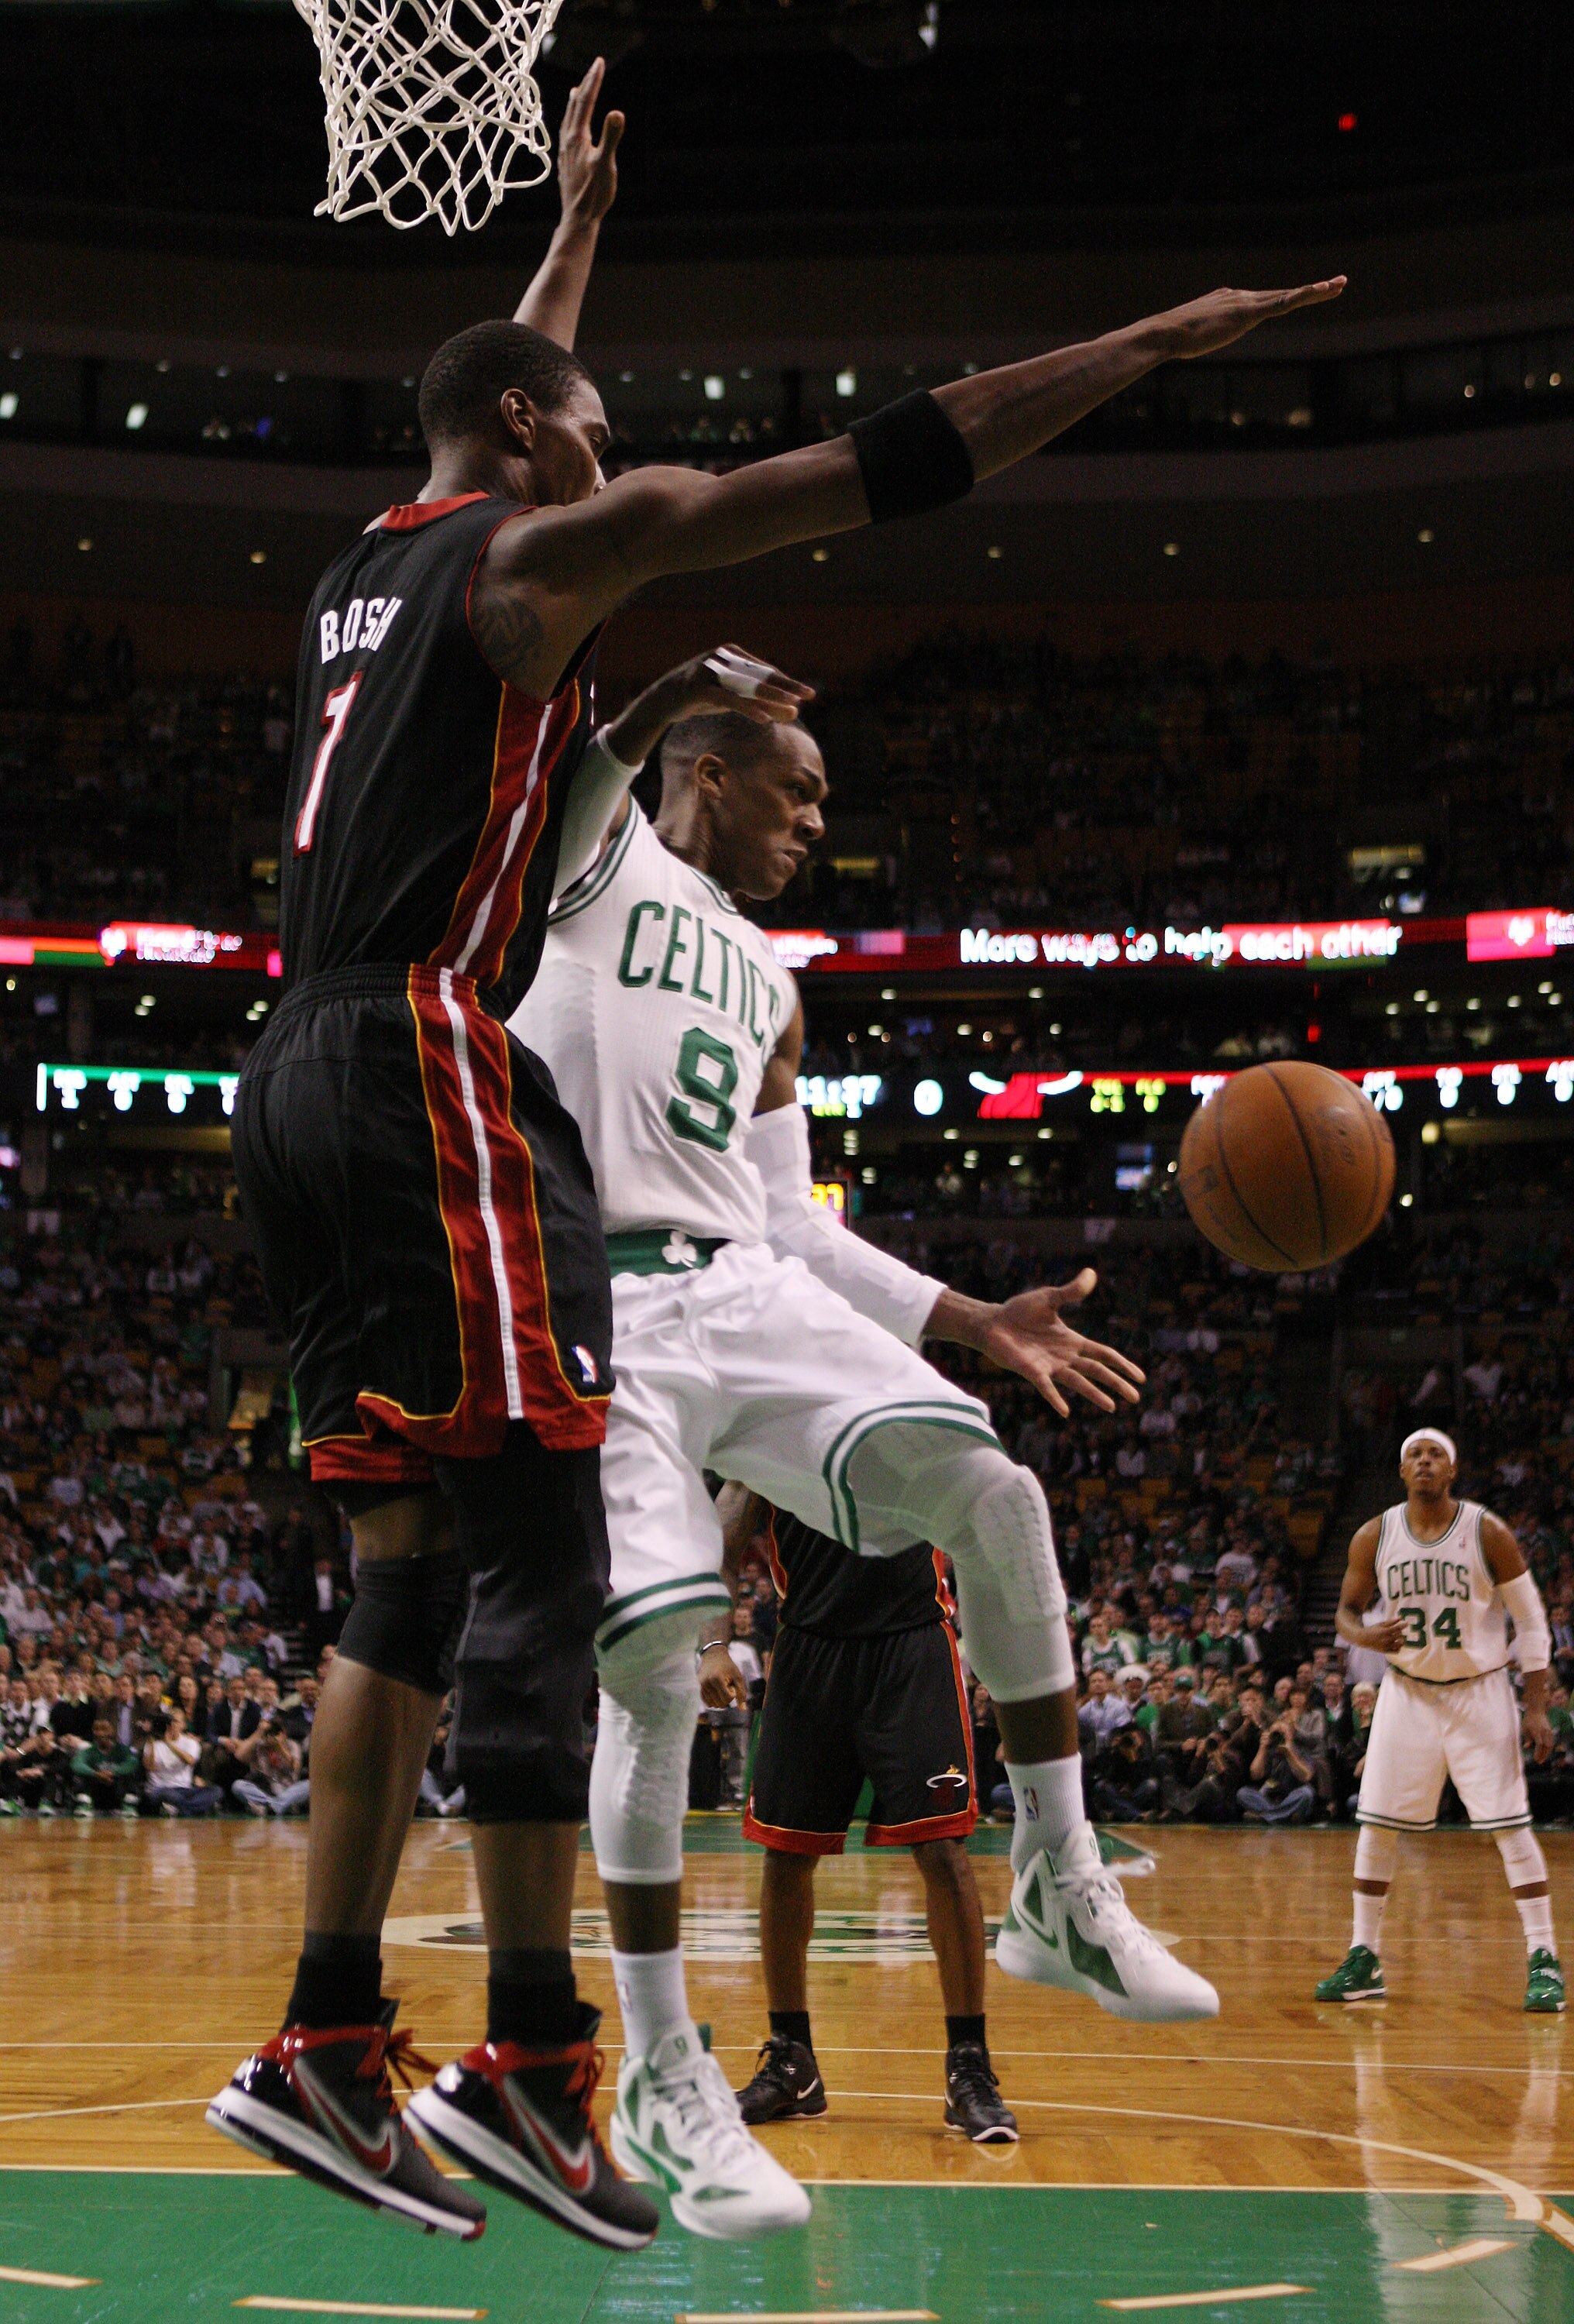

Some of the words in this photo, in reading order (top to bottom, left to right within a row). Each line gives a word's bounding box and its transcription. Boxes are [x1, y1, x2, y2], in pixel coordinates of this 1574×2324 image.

[320, 597, 402, 665] BOSH
[961, 927, 1039, 962] More
[1041, 932, 1120, 968] ways
[1164, 926, 1233, 967] help
[1239, 926, 1315, 961] each
[1321, 923, 1403, 960] other
[664, 1026, 738, 1153] 9
[1387, 1559, 1469, 1602] CELTICS
[1397, 1607, 1462, 1649] 34
